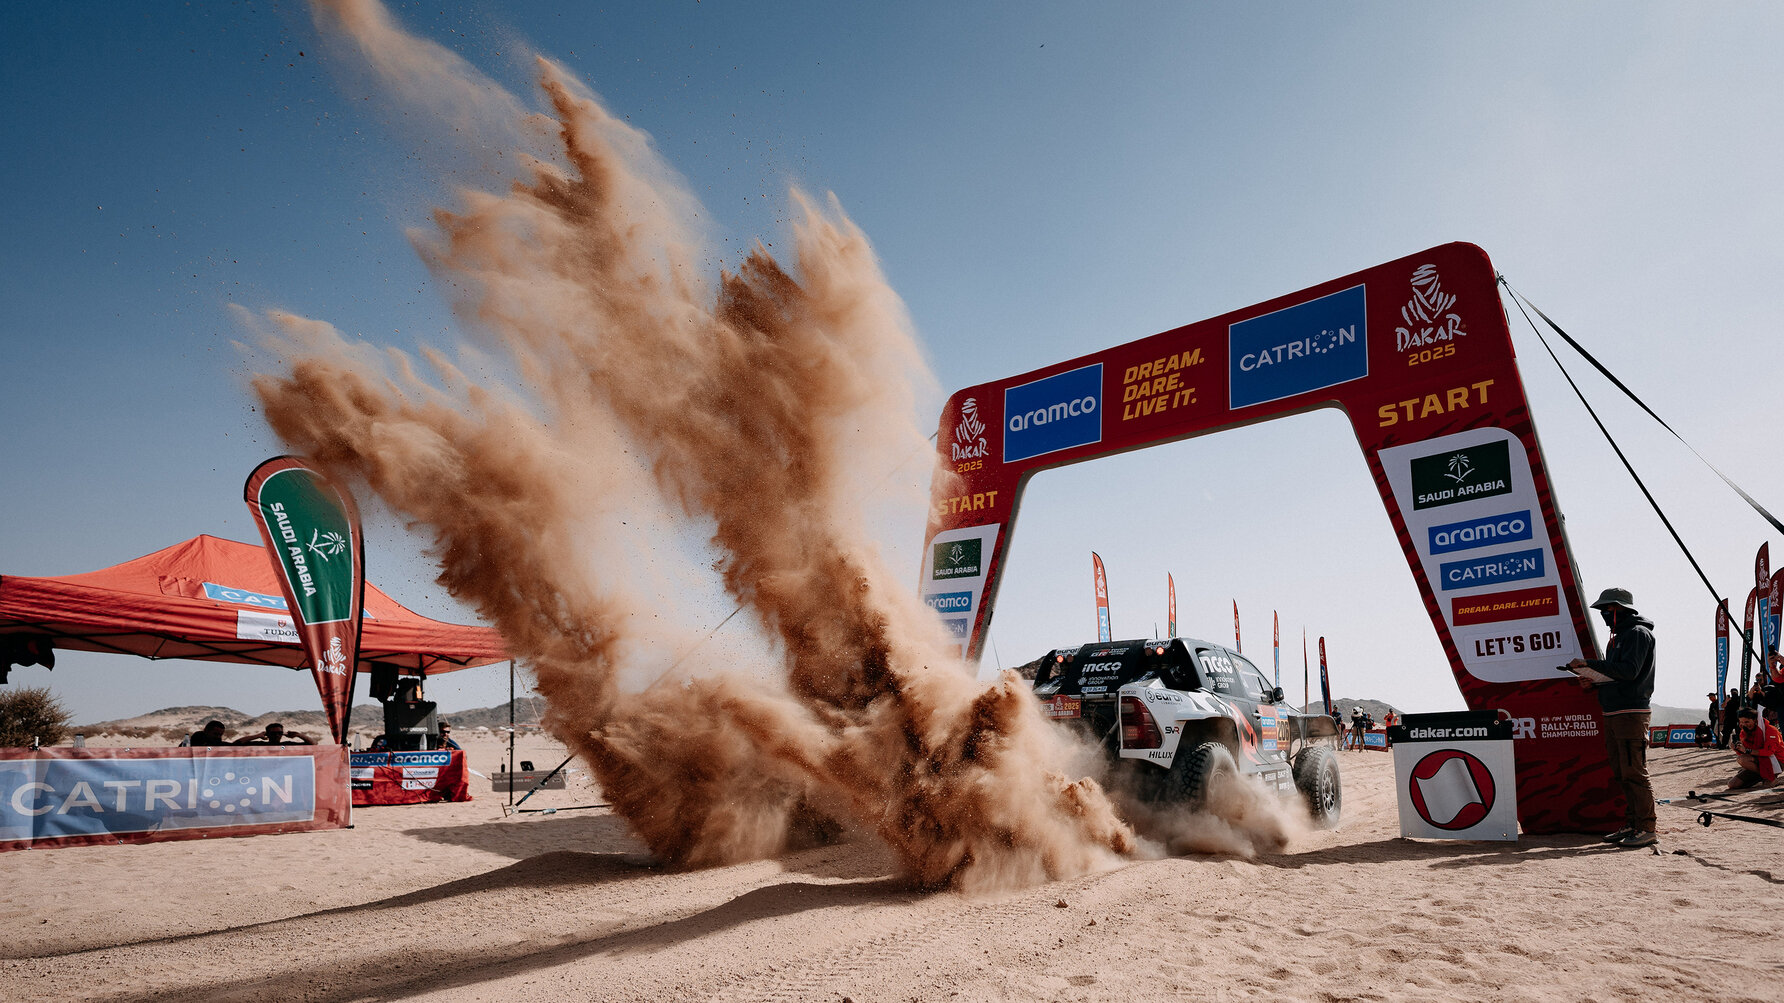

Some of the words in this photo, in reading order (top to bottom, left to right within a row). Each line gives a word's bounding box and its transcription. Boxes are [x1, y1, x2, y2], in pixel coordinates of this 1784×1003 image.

[1395, 313, 1467, 352] DAKAR
[1240, 324, 1356, 372] CATRION
[1408, 343, 1456, 366] 2025
[1123, 348, 1205, 384] DREAM.
[1123, 372, 1185, 402] DARE.
[1009, 396, 1097, 432] aramco
[1122, 394, 1169, 421] LIVE
[1172, 387, 1197, 409] IT.
[1378, 379, 1495, 427] START
[952, 437, 990, 462] DAKAR
[957, 460, 983, 473] 2025
[938, 491, 998, 516] START
[1418, 489, 1454, 504] SAUDI
[1457, 479, 1506, 497] ARABIA
[1435, 519, 1525, 546] aramco
[269, 502, 298, 544] SAUDI
[288, 545, 317, 598] ARABIA
[935, 568, 954, 577] SAUDI
[954, 565, 978, 575] ARABIA
[1449, 557, 1536, 582] CATRION
[926, 596, 969, 608] aramco
[1458, 605, 1491, 615] DREAM.
[1493, 602, 1519, 611] DARE.
[1520, 598, 1541, 608] LIVE
[1542, 597, 1553, 605] IT.
[264, 628, 299, 637] TUDOR
[1475, 635, 1525, 657] LET'S
[1530, 631, 1562, 651] GO!
[317, 659, 347, 677] DAKAR
[1064, 702, 1080, 711] 2025
[1564, 714, 1592, 722] WORLD
[1410, 726, 1488, 739] dakar.com
[1541, 721, 1597, 732] RALLY-RAID
[1541, 729, 1599, 739] CHAMPIONSHIP
[1672, 731, 1696, 740] ara
[395, 754, 449, 764] aramco
[1148, 751, 1173, 759] HILUX
[11, 771, 293, 817] CATRION
